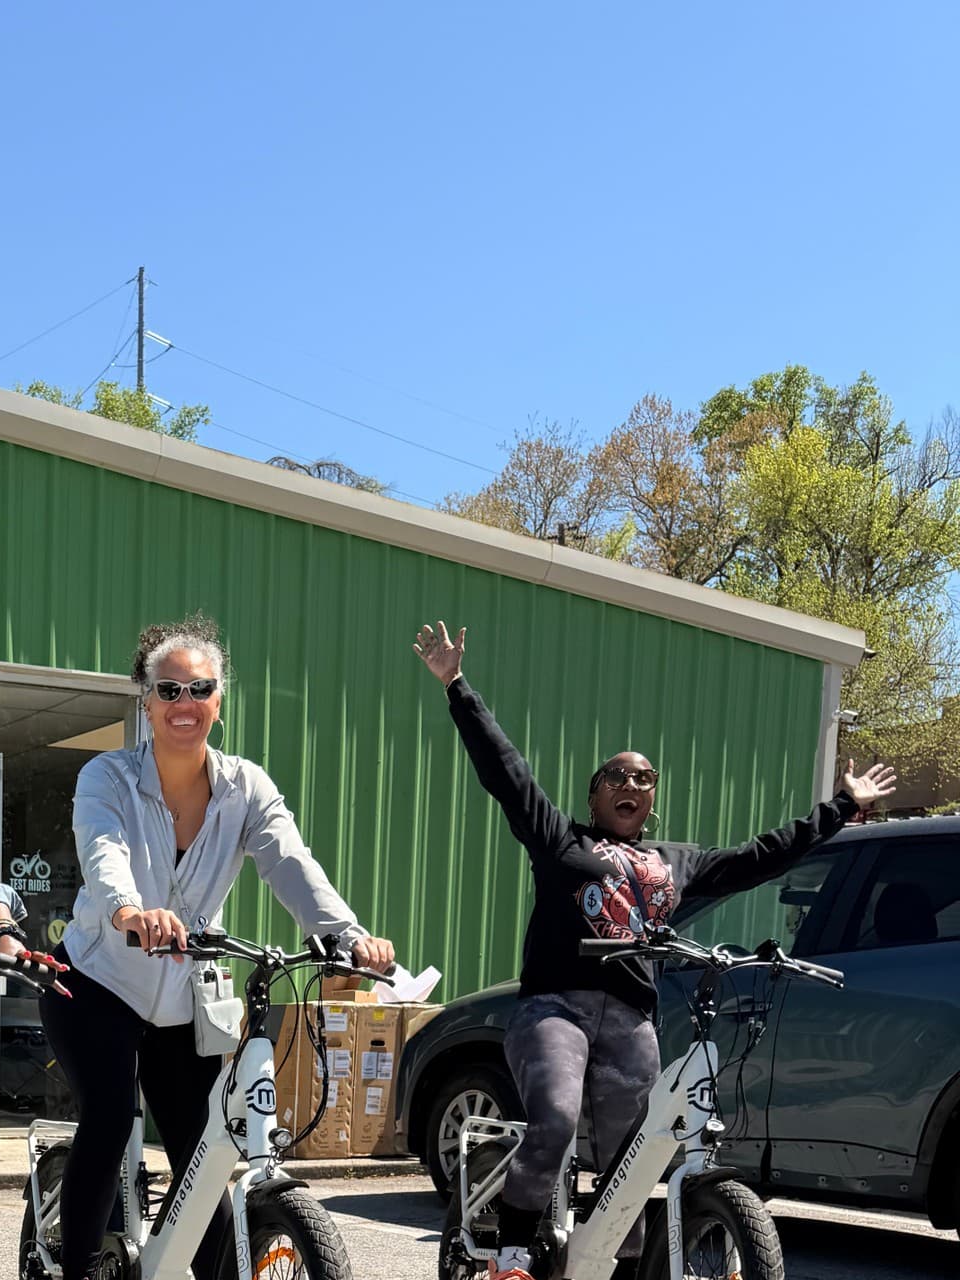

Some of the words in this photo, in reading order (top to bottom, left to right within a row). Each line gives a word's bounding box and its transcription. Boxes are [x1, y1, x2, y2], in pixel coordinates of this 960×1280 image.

[9, 878, 27, 890] TEST
[28, 879, 51, 892] RIDES
[171, 1139, 208, 1220] magnum
[603, 1132, 646, 1203] magnum
